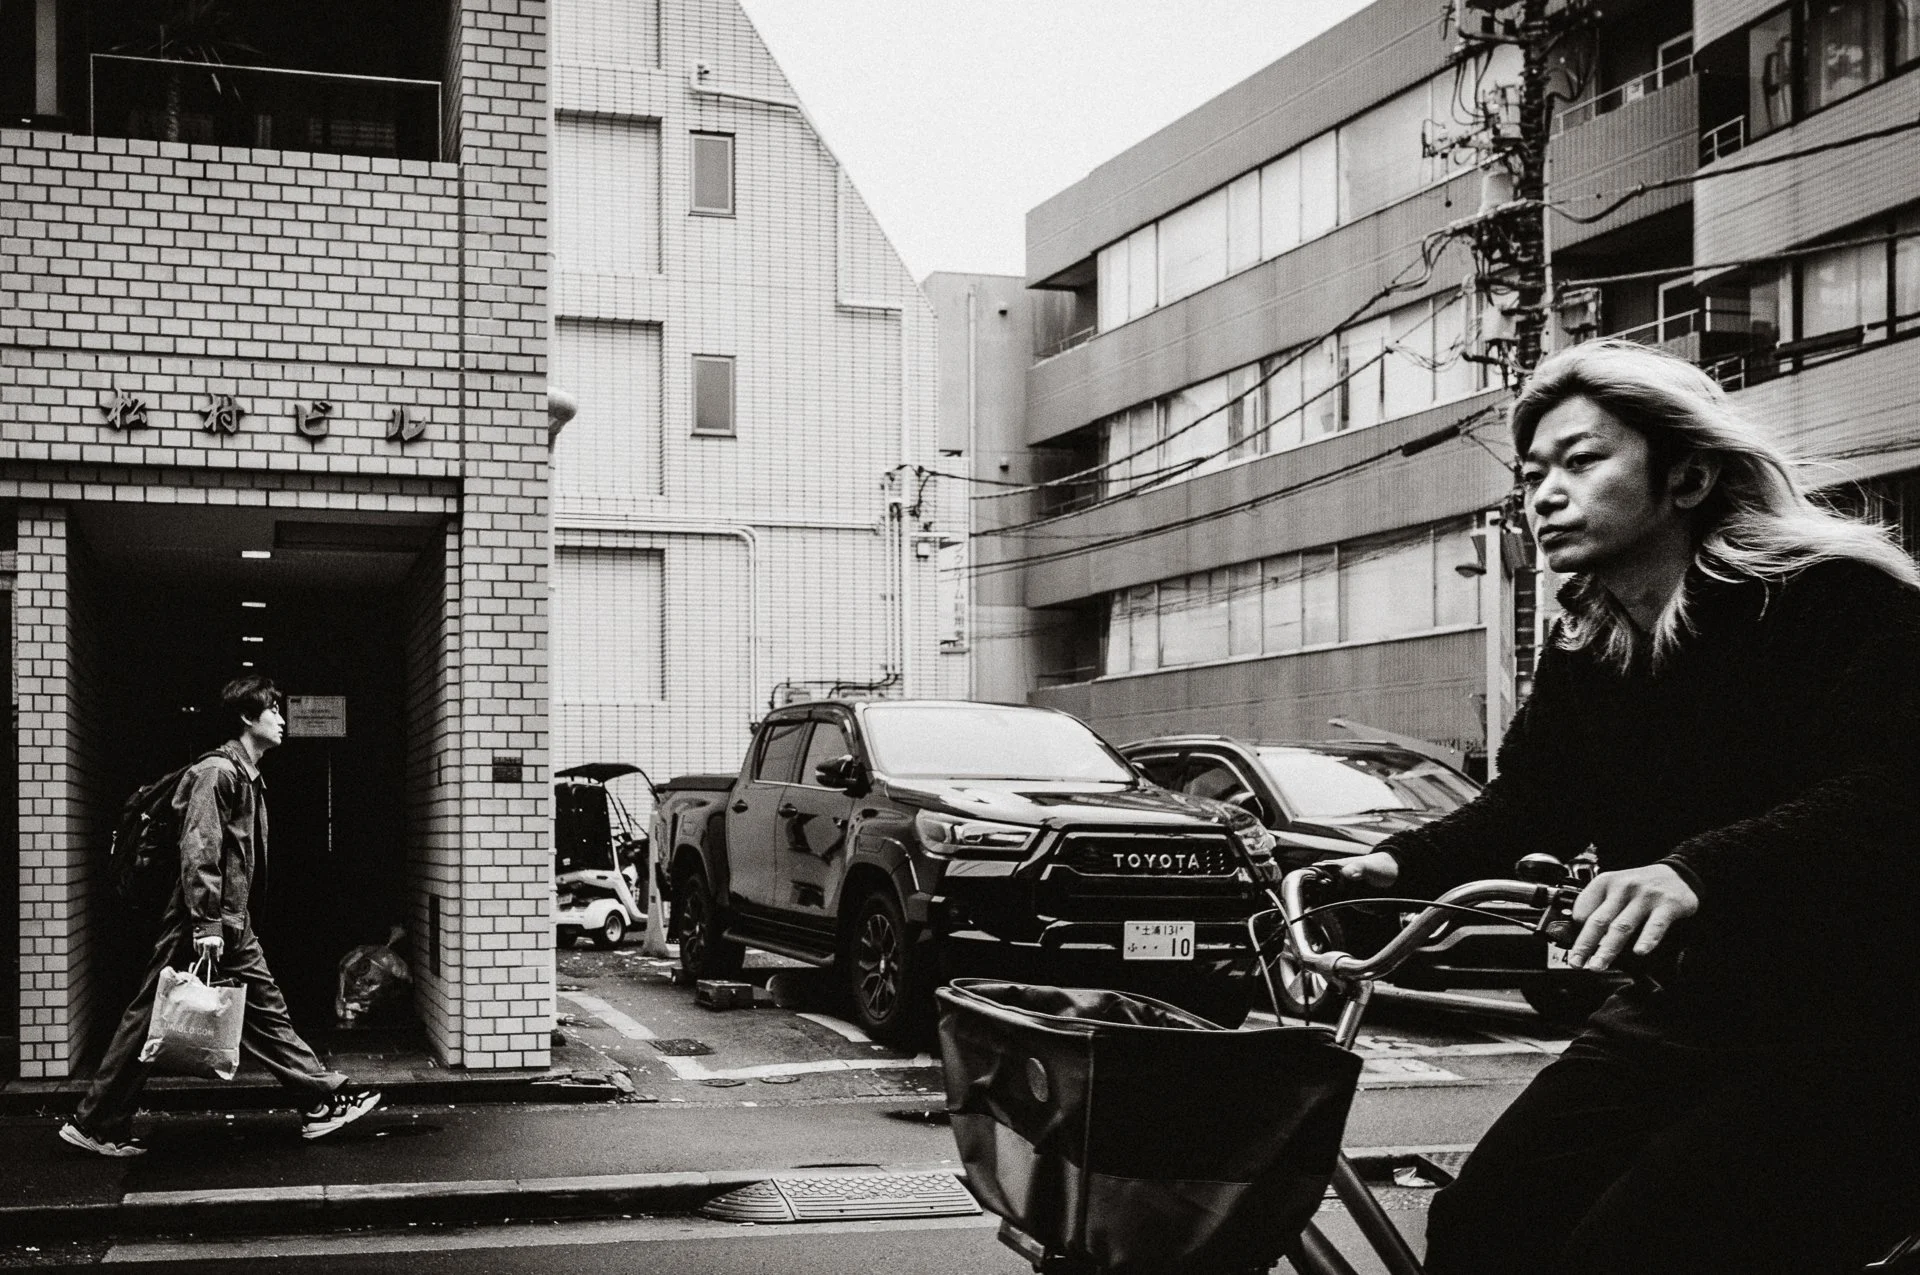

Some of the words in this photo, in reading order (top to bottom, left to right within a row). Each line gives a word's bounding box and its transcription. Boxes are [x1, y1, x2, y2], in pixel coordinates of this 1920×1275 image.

[101, 388, 426, 442] 松村ビル
[1112, 853, 1200, 869] TOYOTA
